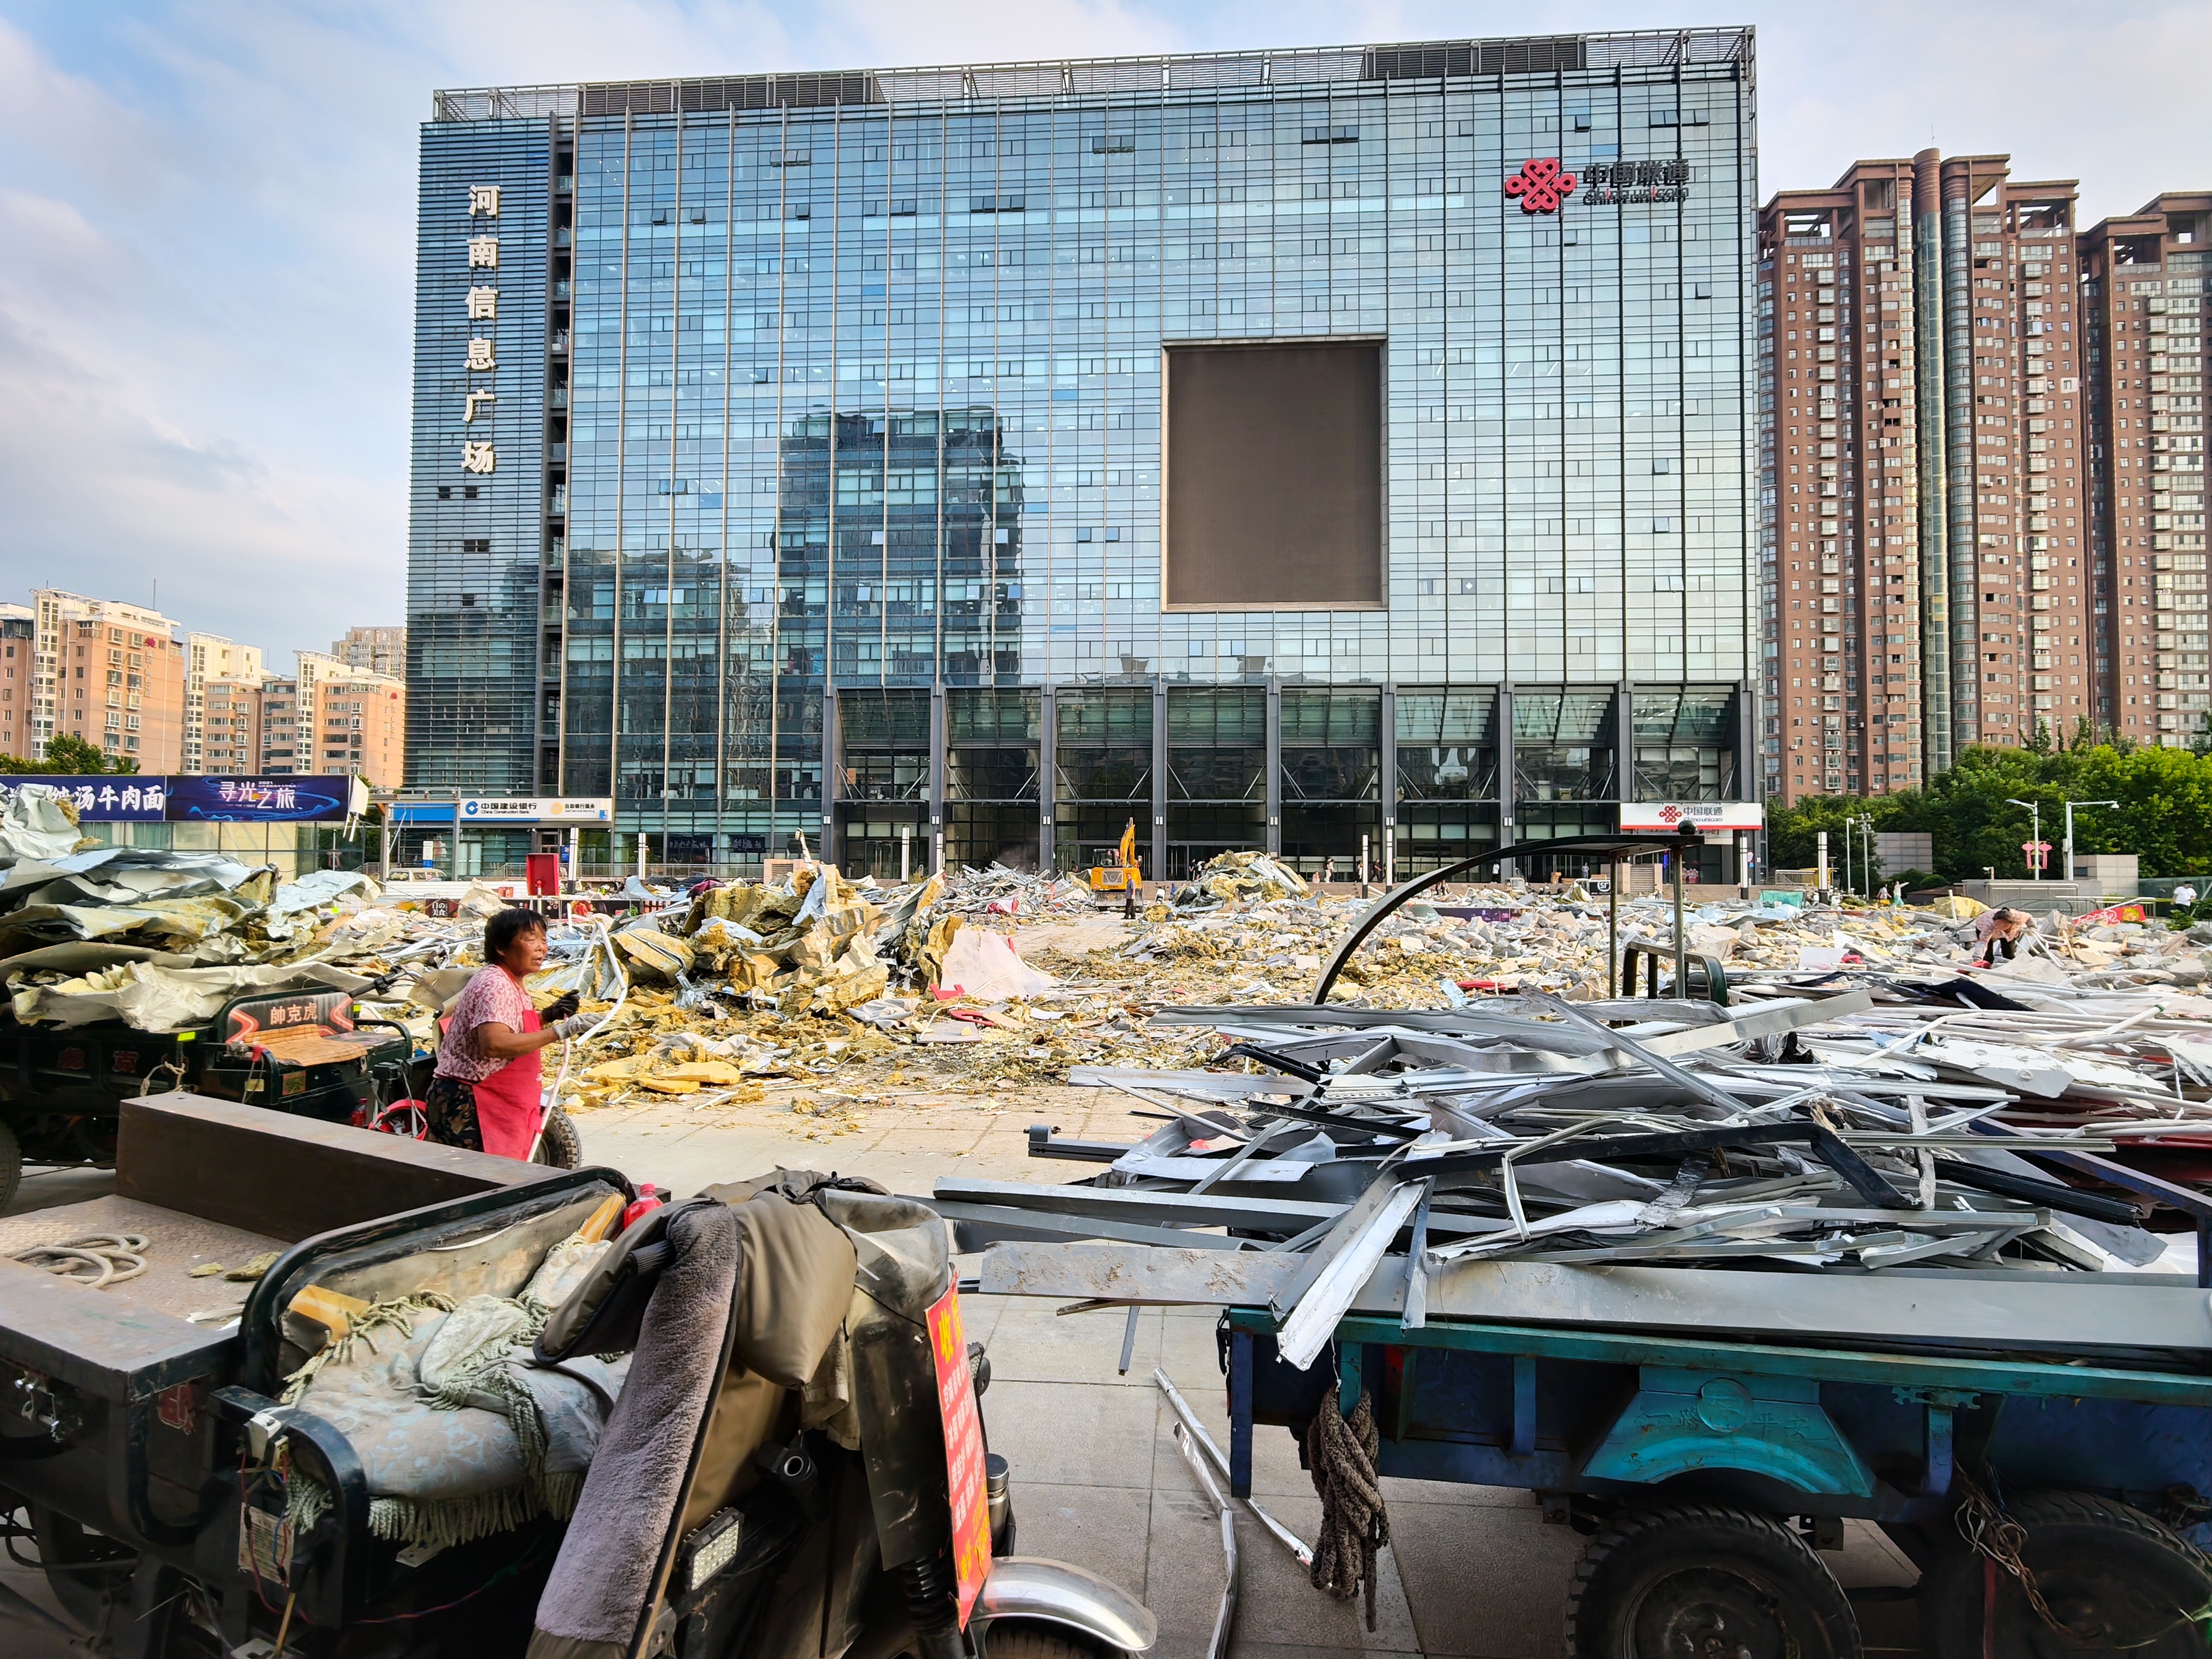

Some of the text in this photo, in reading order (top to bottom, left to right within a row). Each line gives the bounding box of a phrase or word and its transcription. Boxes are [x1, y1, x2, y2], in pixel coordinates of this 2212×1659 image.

[1584, 160, 1689, 184] 中国联通
[461, 185, 500, 474] 河南信息广场
[218, 781, 295, 809] 寻光之旅
[1683, 806, 1723, 815] 中国联通
